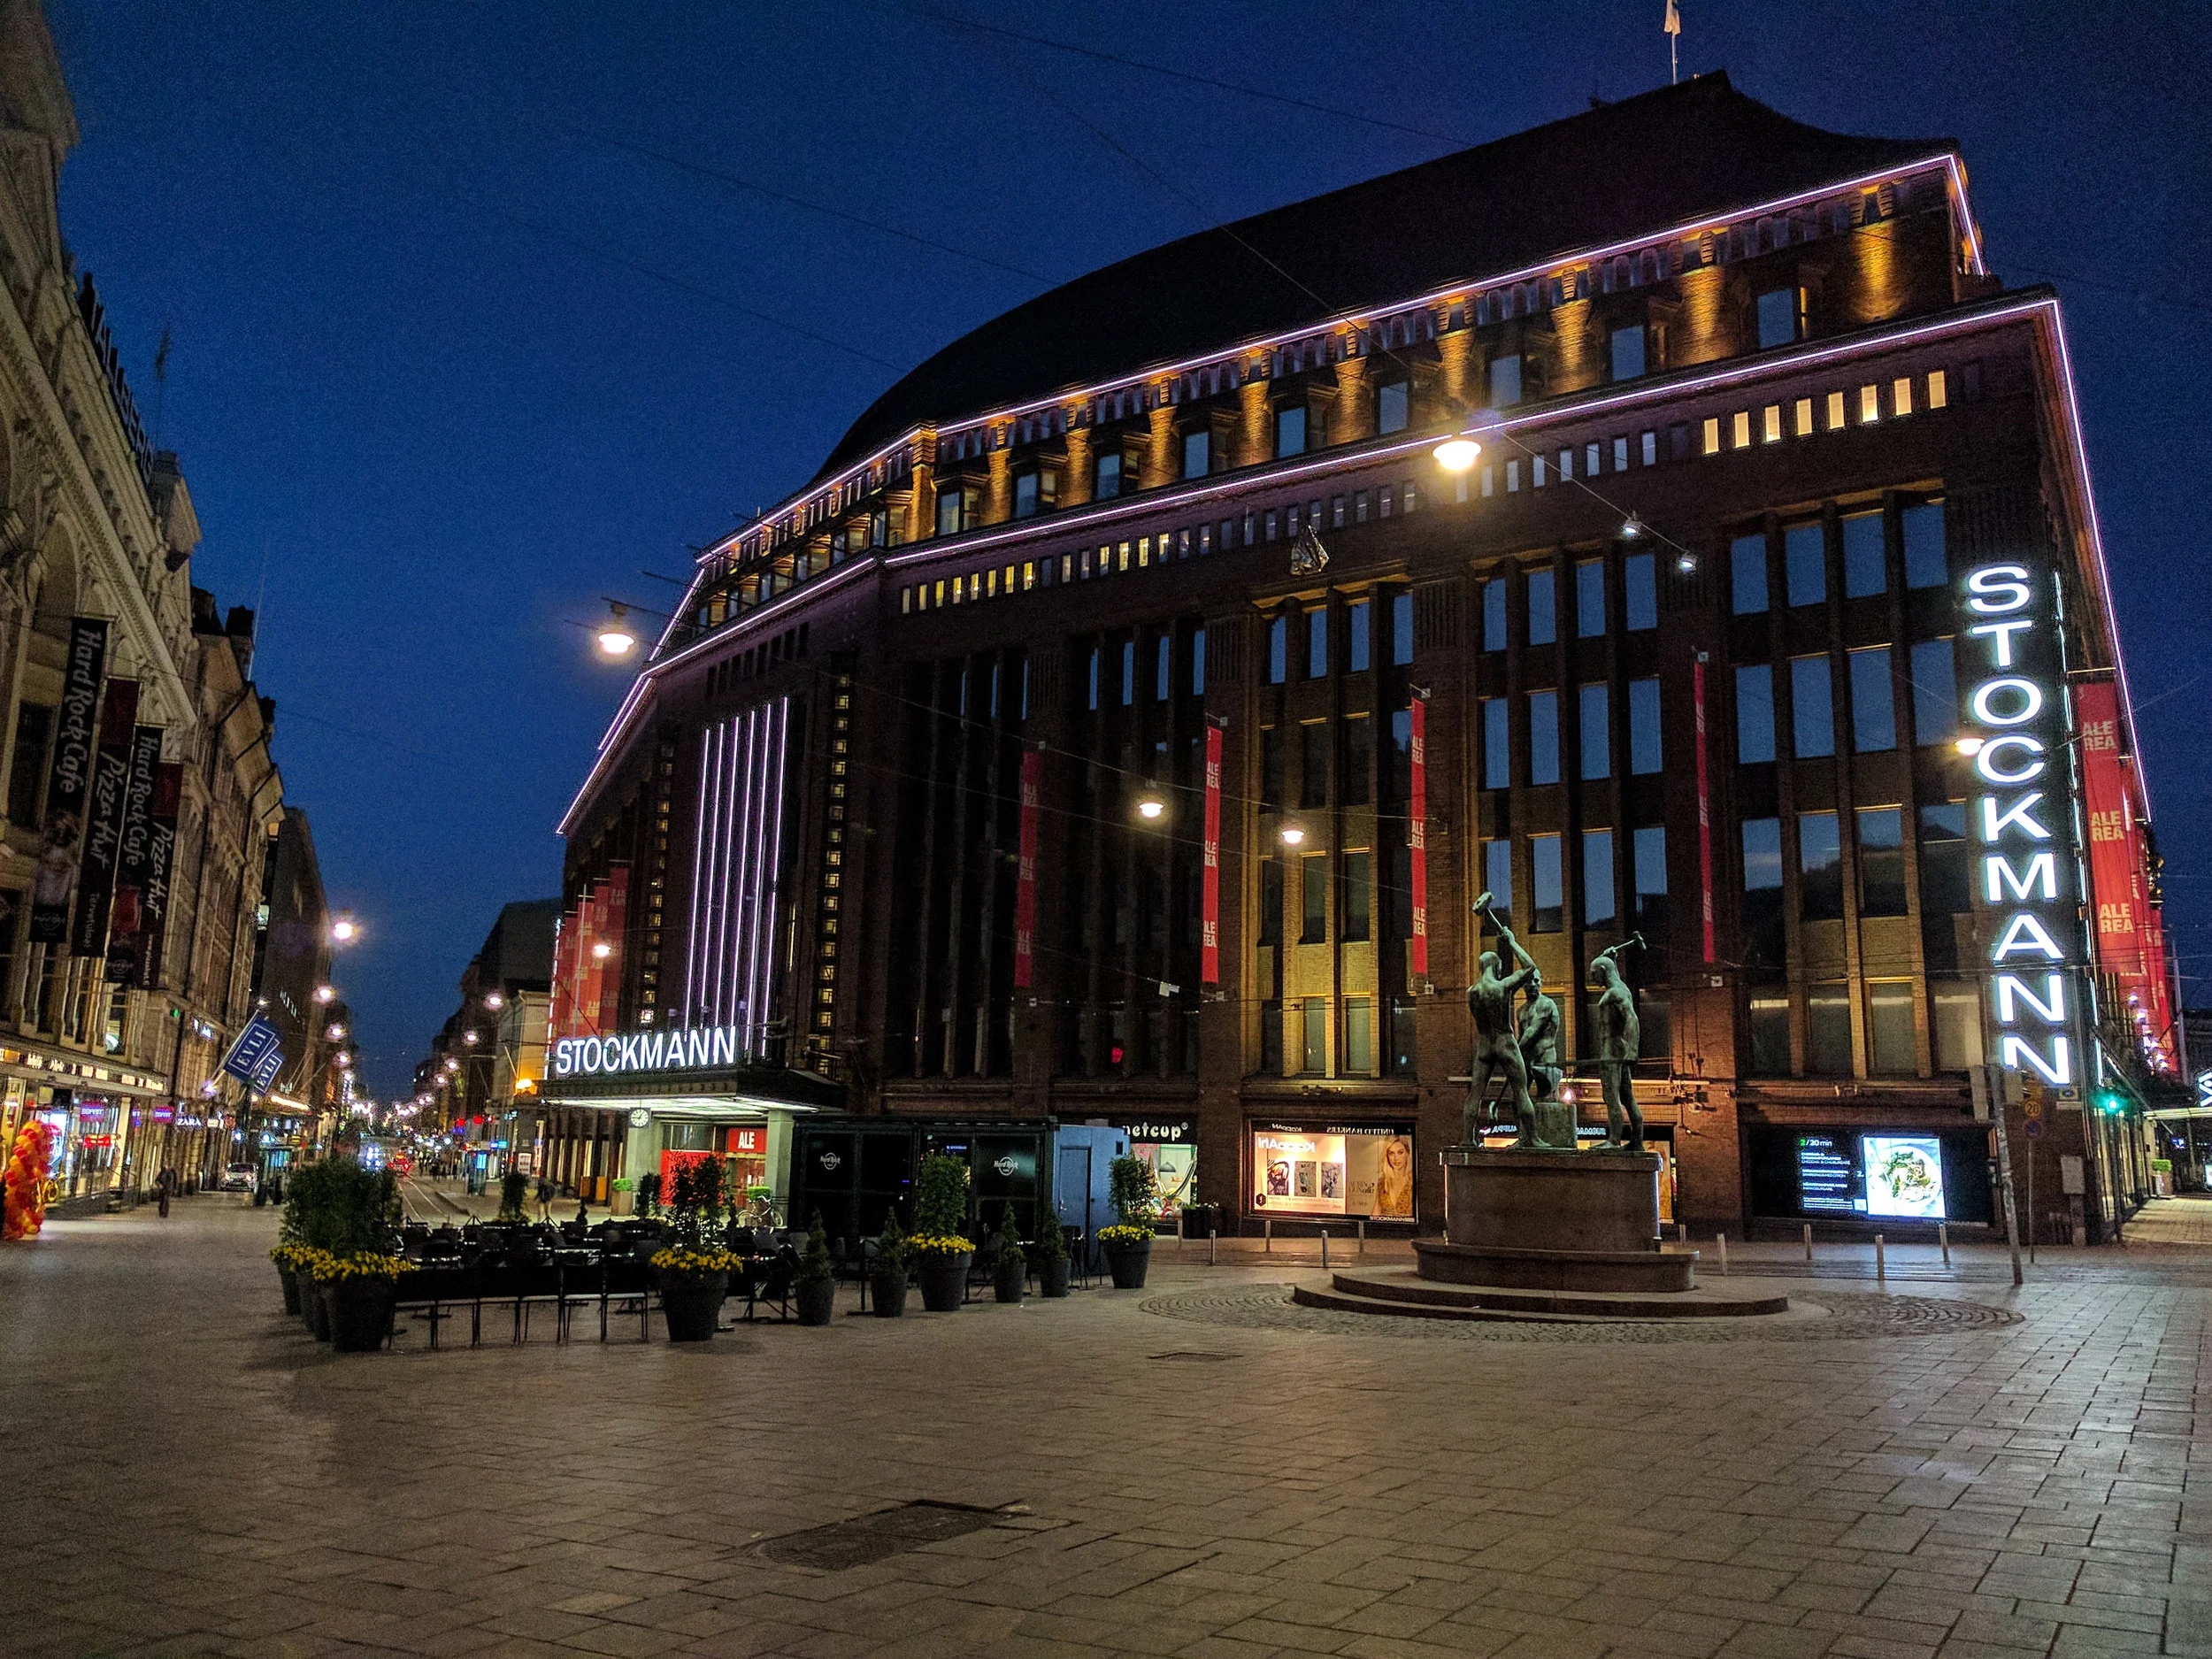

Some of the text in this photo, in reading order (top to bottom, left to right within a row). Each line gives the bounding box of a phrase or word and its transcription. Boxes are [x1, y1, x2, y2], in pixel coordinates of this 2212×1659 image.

[56, 627, 103, 794] Hard Rock Cafe
[2082, 721, 2114, 735] ALE
[2084, 735, 2117, 750] REA
[1207, 761, 1219, 775] ALE
[1207, 774, 1219, 788] REA
[123, 735, 159, 866] Hard Rock Cafe
[90, 751, 127, 870] Pizza Hut
[2091, 810, 2122, 826] ALE
[1412, 820, 1424, 835] ALE
[1967, 565, 2070, 1087] STOCKMANN
[2092, 826, 2124, 841] REA
[1412, 834, 1425, 849] REA
[146, 821, 174, 920] Pizza Hut
[1413, 906, 1425, 922] ALE
[2100, 902, 2131, 918] ALE
[1413, 921, 1426, 937] REA
[2100, 918, 2134, 933] REA
[236, 1031, 266, 1067] EVLI
[556, 1026, 737, 1074] STOCKMANN
[257, 1058, 277, 1087] EVLI
[2027, 1102, 2040, 1113] 20
[177, 1118, 202, 1126] ZARA
[737, 1131, 755, 1149] ALE
